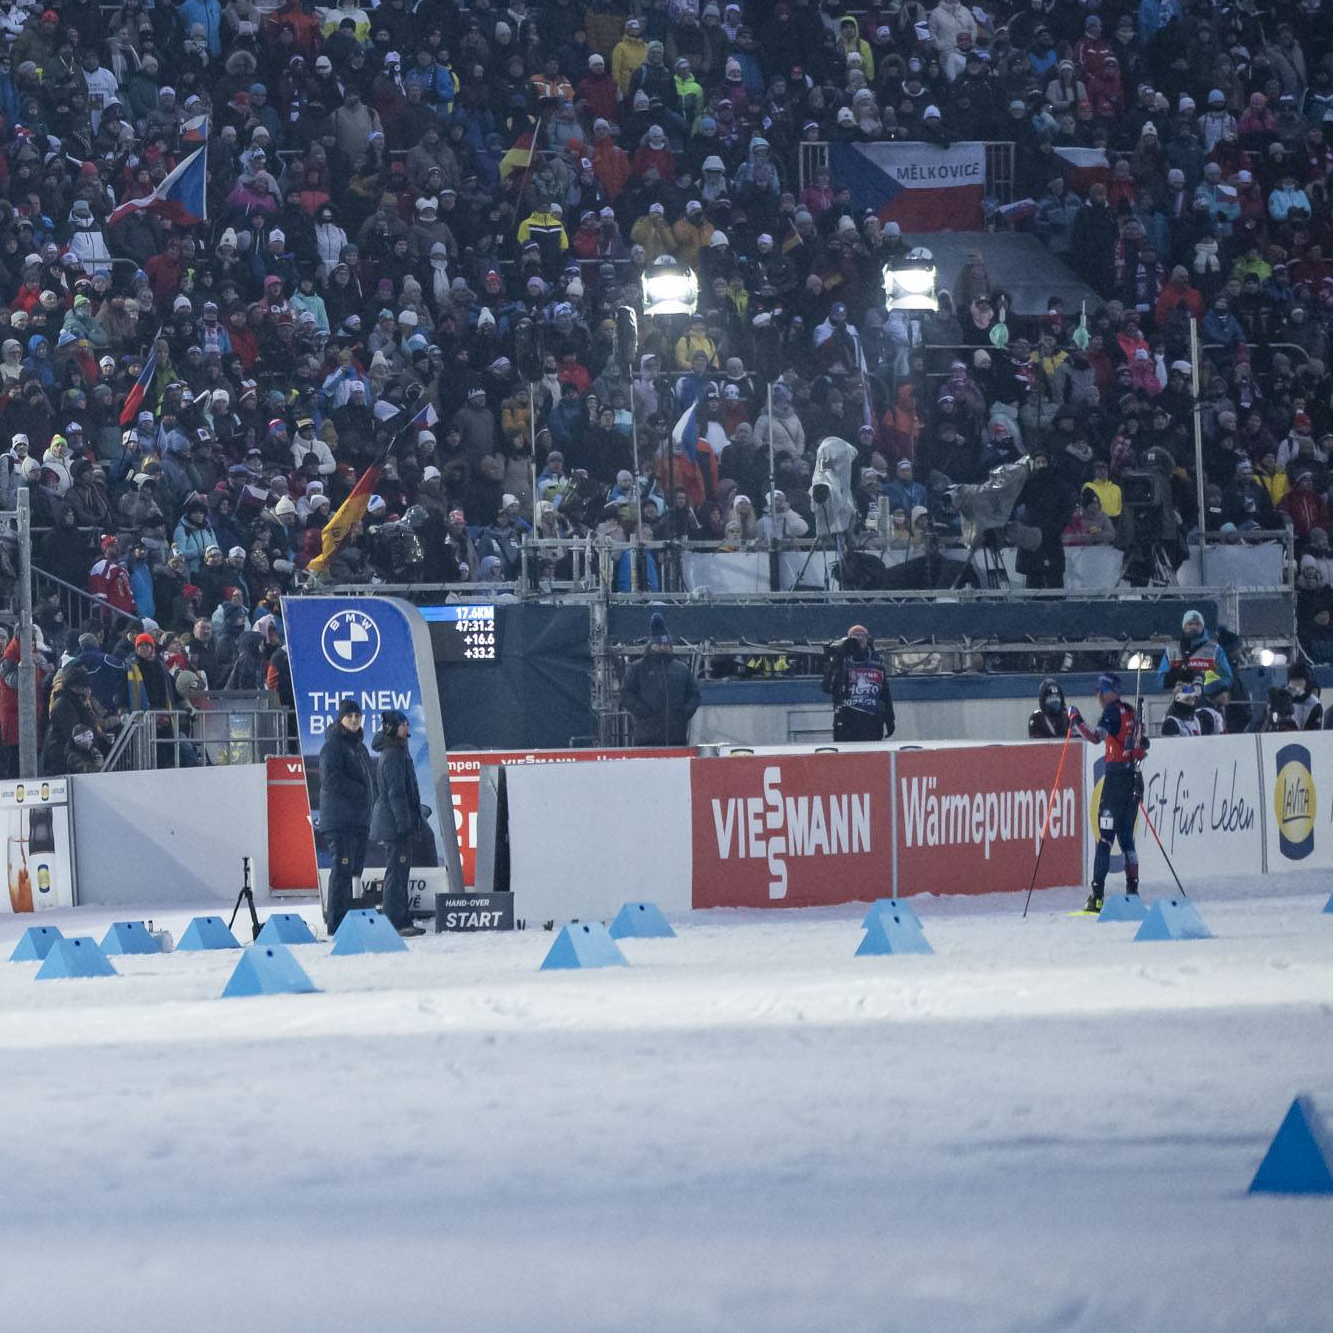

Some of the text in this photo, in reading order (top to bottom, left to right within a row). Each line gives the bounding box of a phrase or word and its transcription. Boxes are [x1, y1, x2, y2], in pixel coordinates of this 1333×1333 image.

[455, 607, 494, 619] 17.6KM
[329, 613, 372, 631] BMW
[455, 620, 494, 631] 47:31.2
[464, 633, 495, 645] +16.6
[464, 647, 495, 659] +33.2
[361, 690, 412, 710] NEW
[1171, 770, 1204, 855] fürs
[1211, 759, 1254, 831] Leben
[901, 776, 1075, 860] Wärmepumpen
[711, 766, 870, 900] VIESSMANN
[445, 899, 490, 907] HAND-OVER
[445, 911, 503, 928] START
